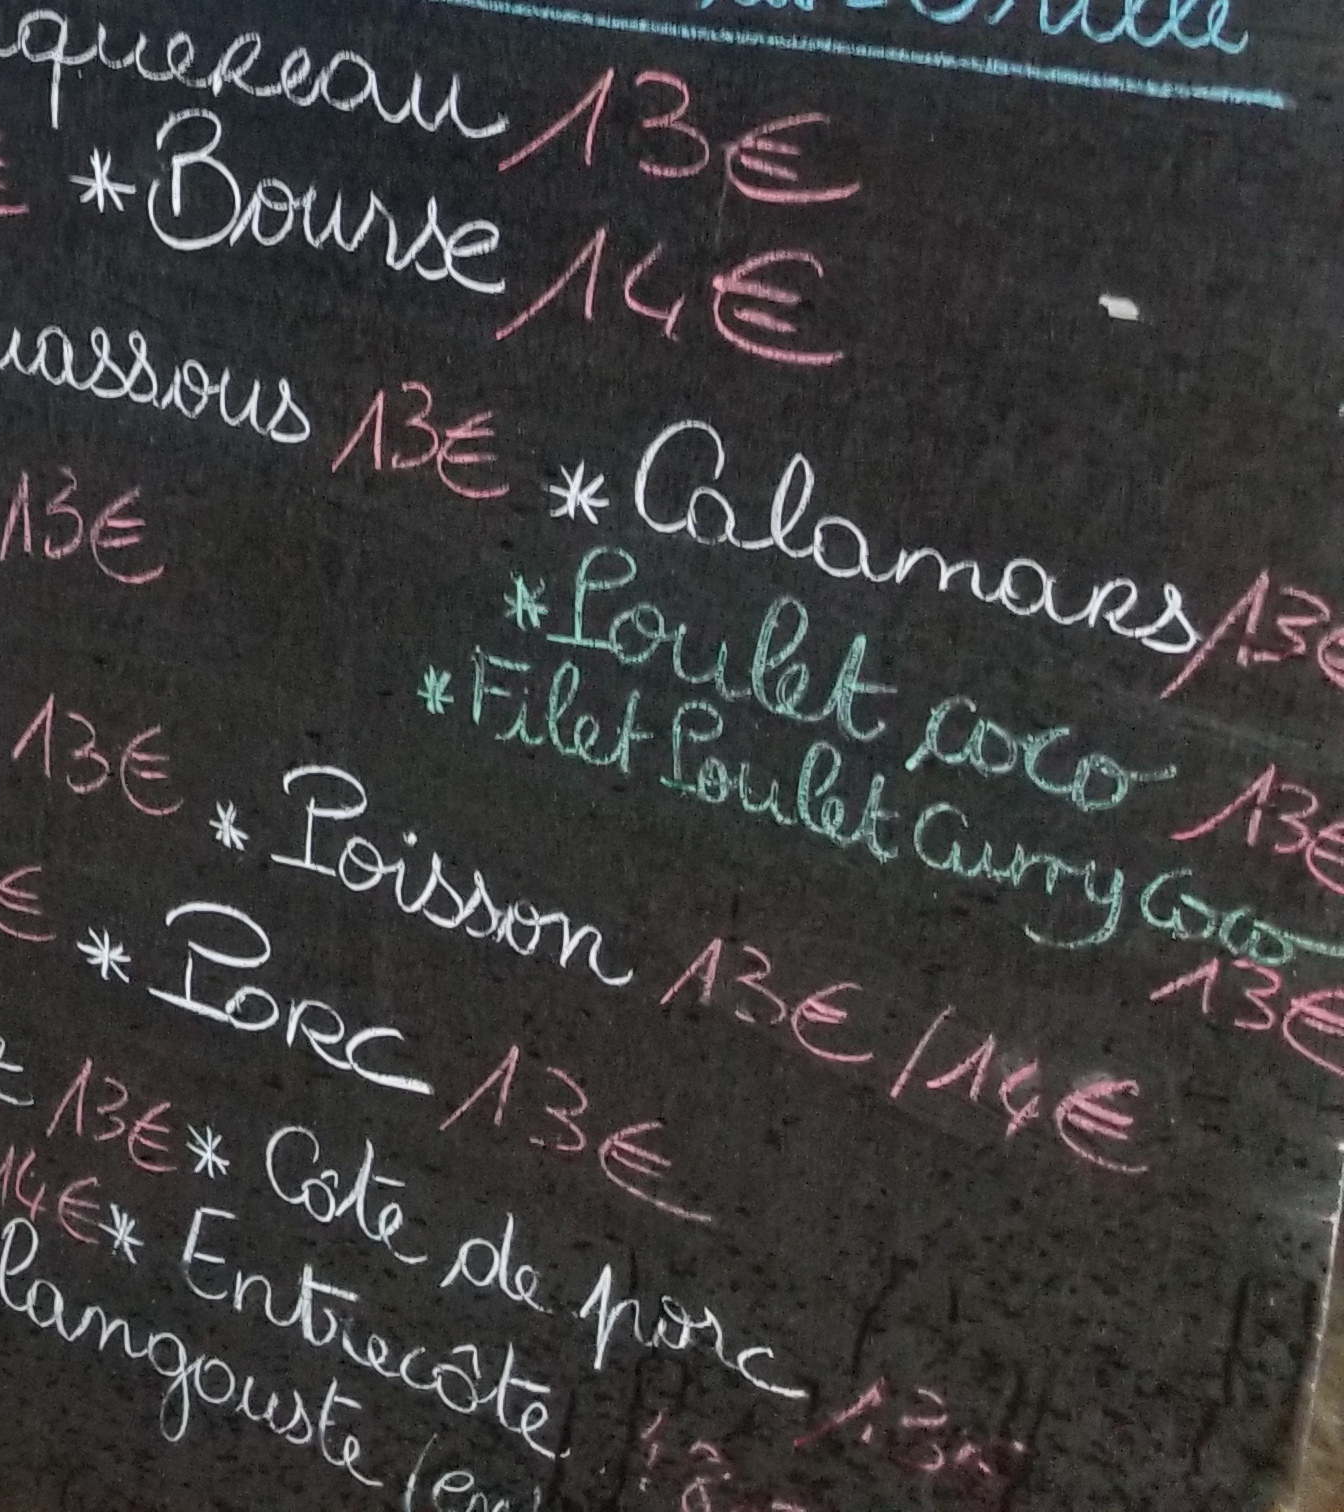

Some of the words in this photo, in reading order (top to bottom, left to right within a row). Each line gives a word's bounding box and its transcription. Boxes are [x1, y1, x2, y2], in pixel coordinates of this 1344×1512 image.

[499, 67, 861, 204] 13€
[147, 107, 506, 295] Bourse
[497, 226, 844, 367] 14€
[330, 381, 511, 500] 13€
[0, 466, 165, 586] 13€
[548, 545, 899, 742] Poulet
[12, 692, 185, 816] 13€
[471, 645, 654, 776] Filet
[658, 699, 902, 866] Poulet
[270, 765, 634, 987] Poisson
[658, 937, 874, 1064] 13€
[47, 1058, 179, 1173] 13€
[437, 1045, 712, 1222] 13€
[441, 1213, 556, 1314] de
